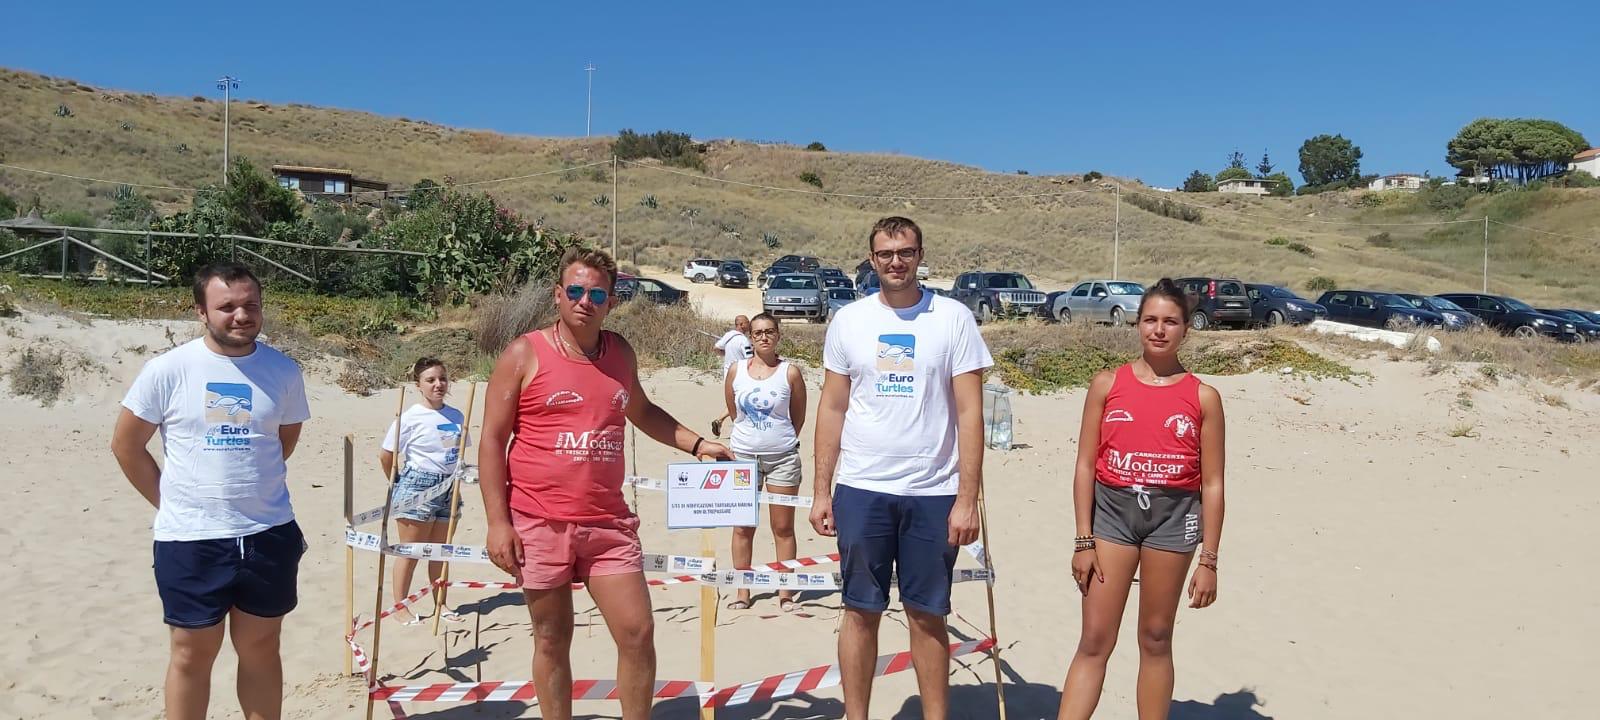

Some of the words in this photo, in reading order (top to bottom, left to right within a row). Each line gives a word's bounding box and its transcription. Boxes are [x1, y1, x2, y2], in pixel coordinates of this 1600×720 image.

[889, 373, 914, 383] Euro
[875, 383, 914, 393] Turtles
[220, 424, 250, 435] Euro
[205, 436, 251, 446] Turtles
[1111, 449, 1184, 474] Modicar
